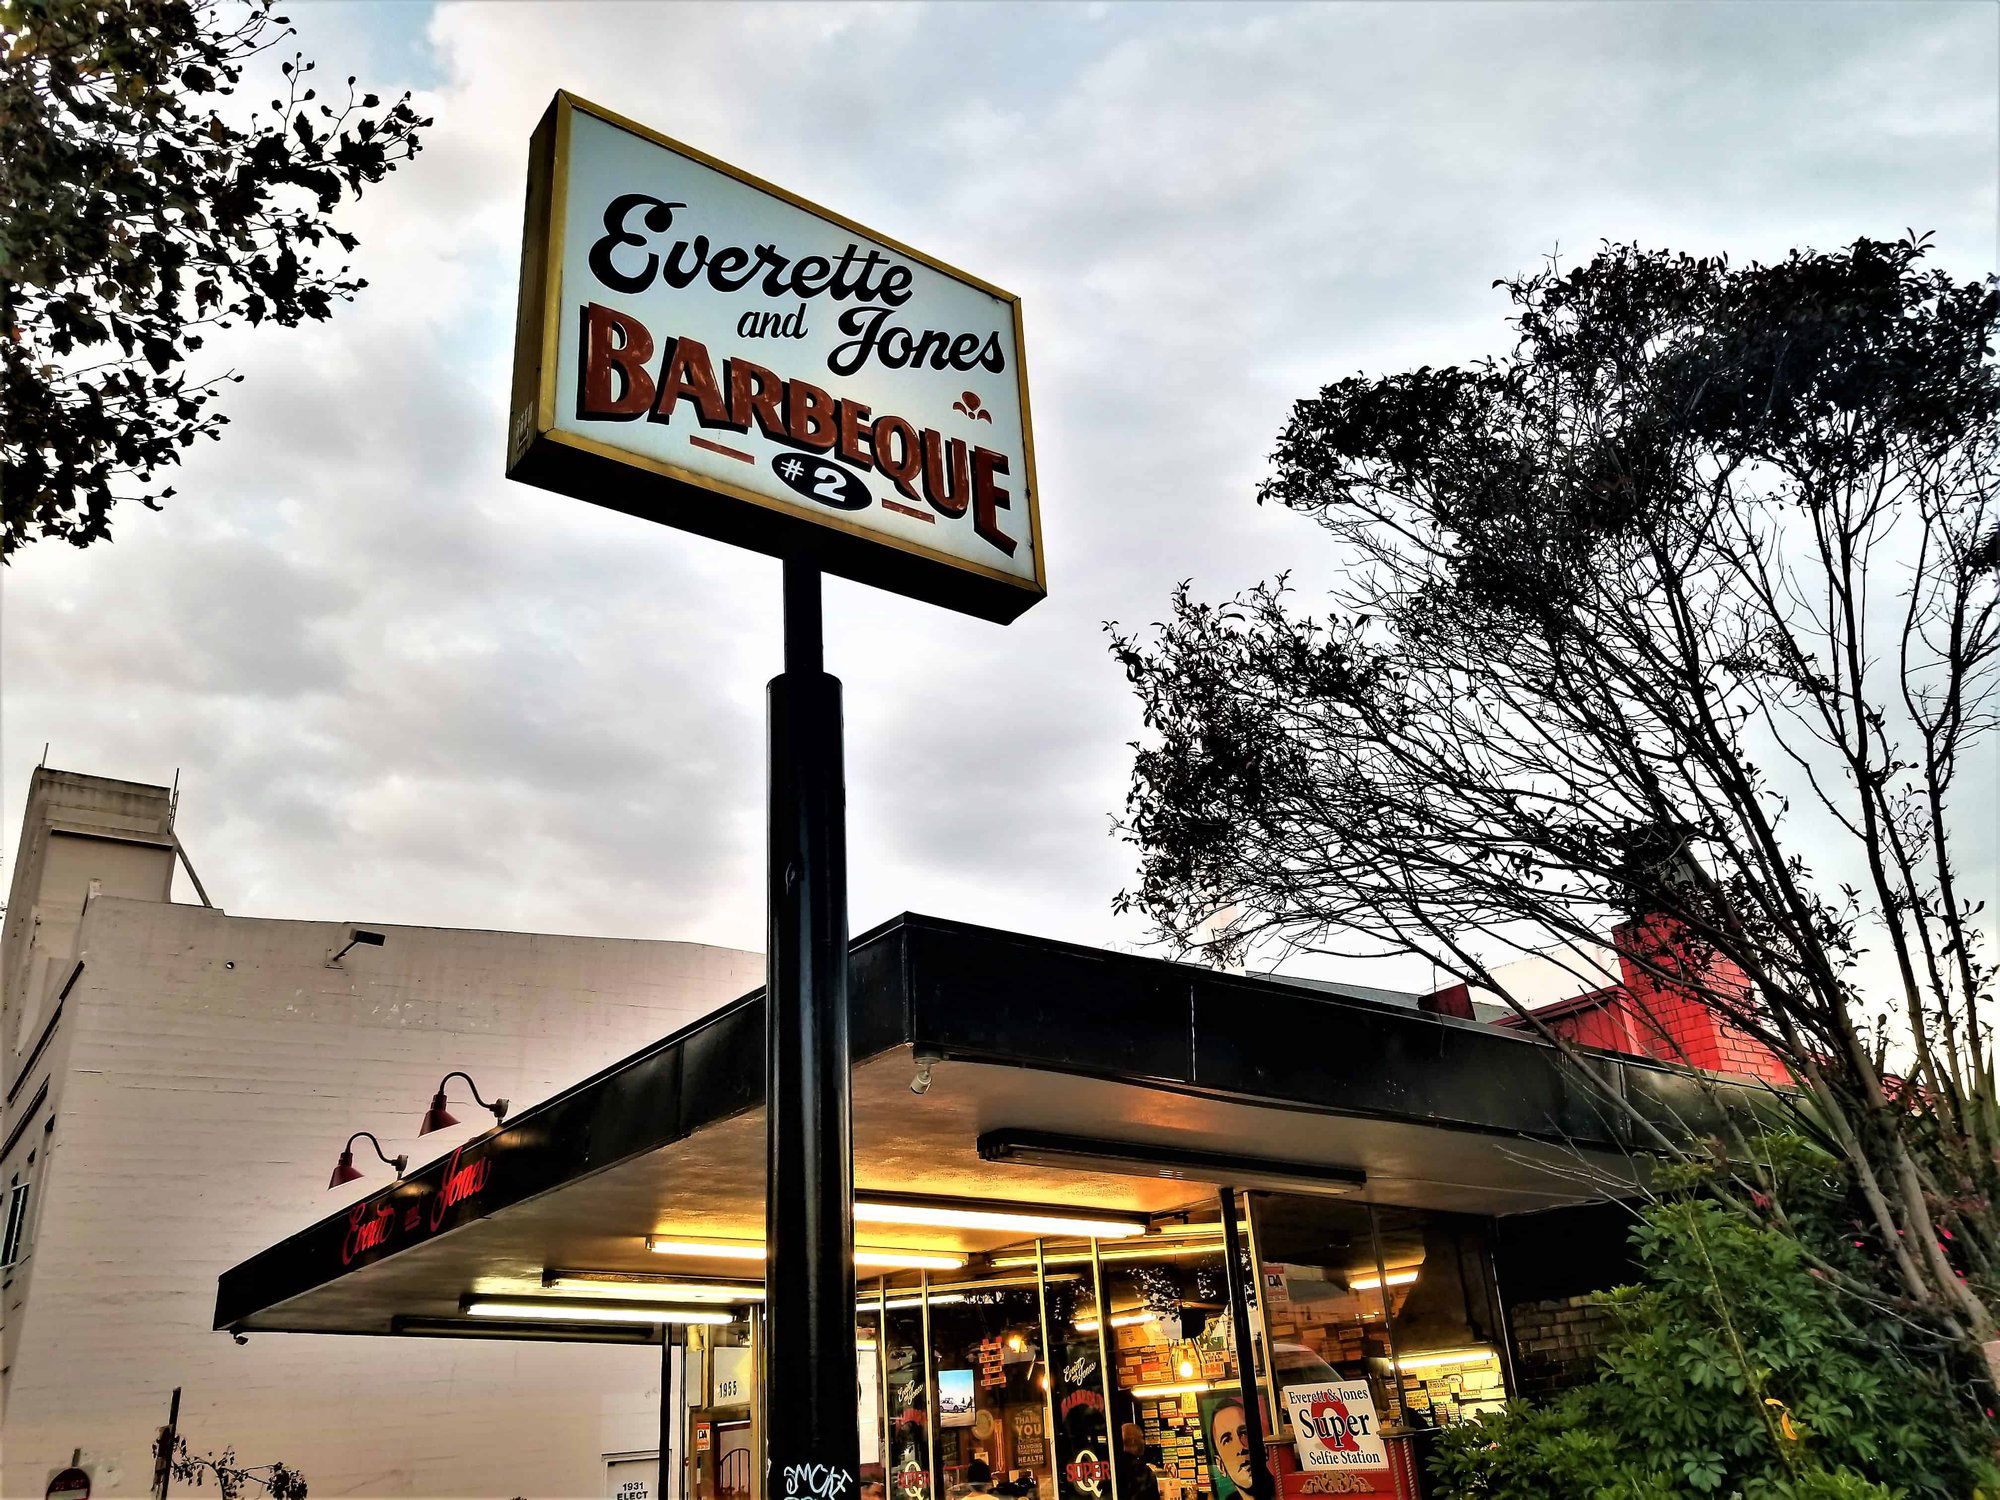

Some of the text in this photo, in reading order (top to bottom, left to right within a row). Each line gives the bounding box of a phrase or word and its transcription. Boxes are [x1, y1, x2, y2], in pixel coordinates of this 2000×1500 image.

[588, 193, 913, 307] Everette
[737, 303, 1005, 377] and Jones
[576, 301, 1018, 558] BARBEQUE
[430, 1146, 492, 1232] Jones
[719, 1380, 737, 1398] 1955
[1288, 1387, 1369, 1404] Everett & Jones
[1016, 1424, 1042, 1436] YOU
[1298, 1408, 1371, 1447] Super
[1018, 1455, 1044, 1463] HEALTH
[1309, 1450, 1381, 1465] Selfie Station
[1066, 1461, 1111, 1482] SUPER
[622, 1481, 644, 1491] 1931
[616, 1491, 649, 1500] ELECT
